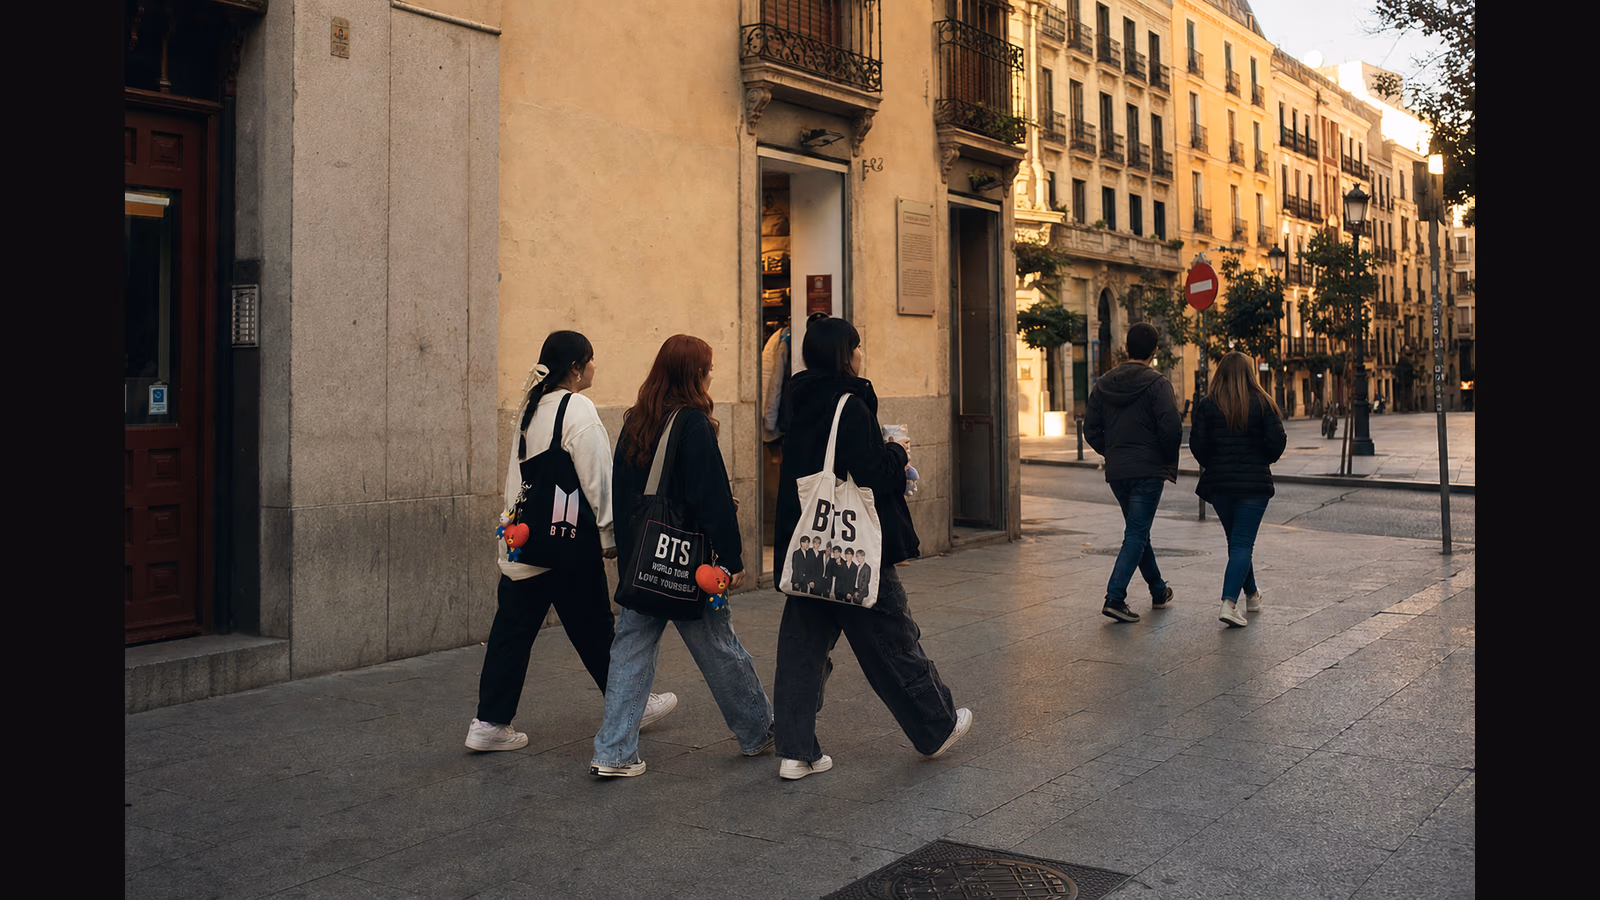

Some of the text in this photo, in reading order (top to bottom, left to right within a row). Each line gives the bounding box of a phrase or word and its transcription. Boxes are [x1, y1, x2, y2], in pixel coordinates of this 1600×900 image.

[811, 498, 857, 542] BTS
[550, 525, 577, 539] BTS
[654, 533, 691, 566] BTS
[651, 562, 690, 579] WORLD TOUR
[638, 572, 697, 593] LOVE YOURSELF
